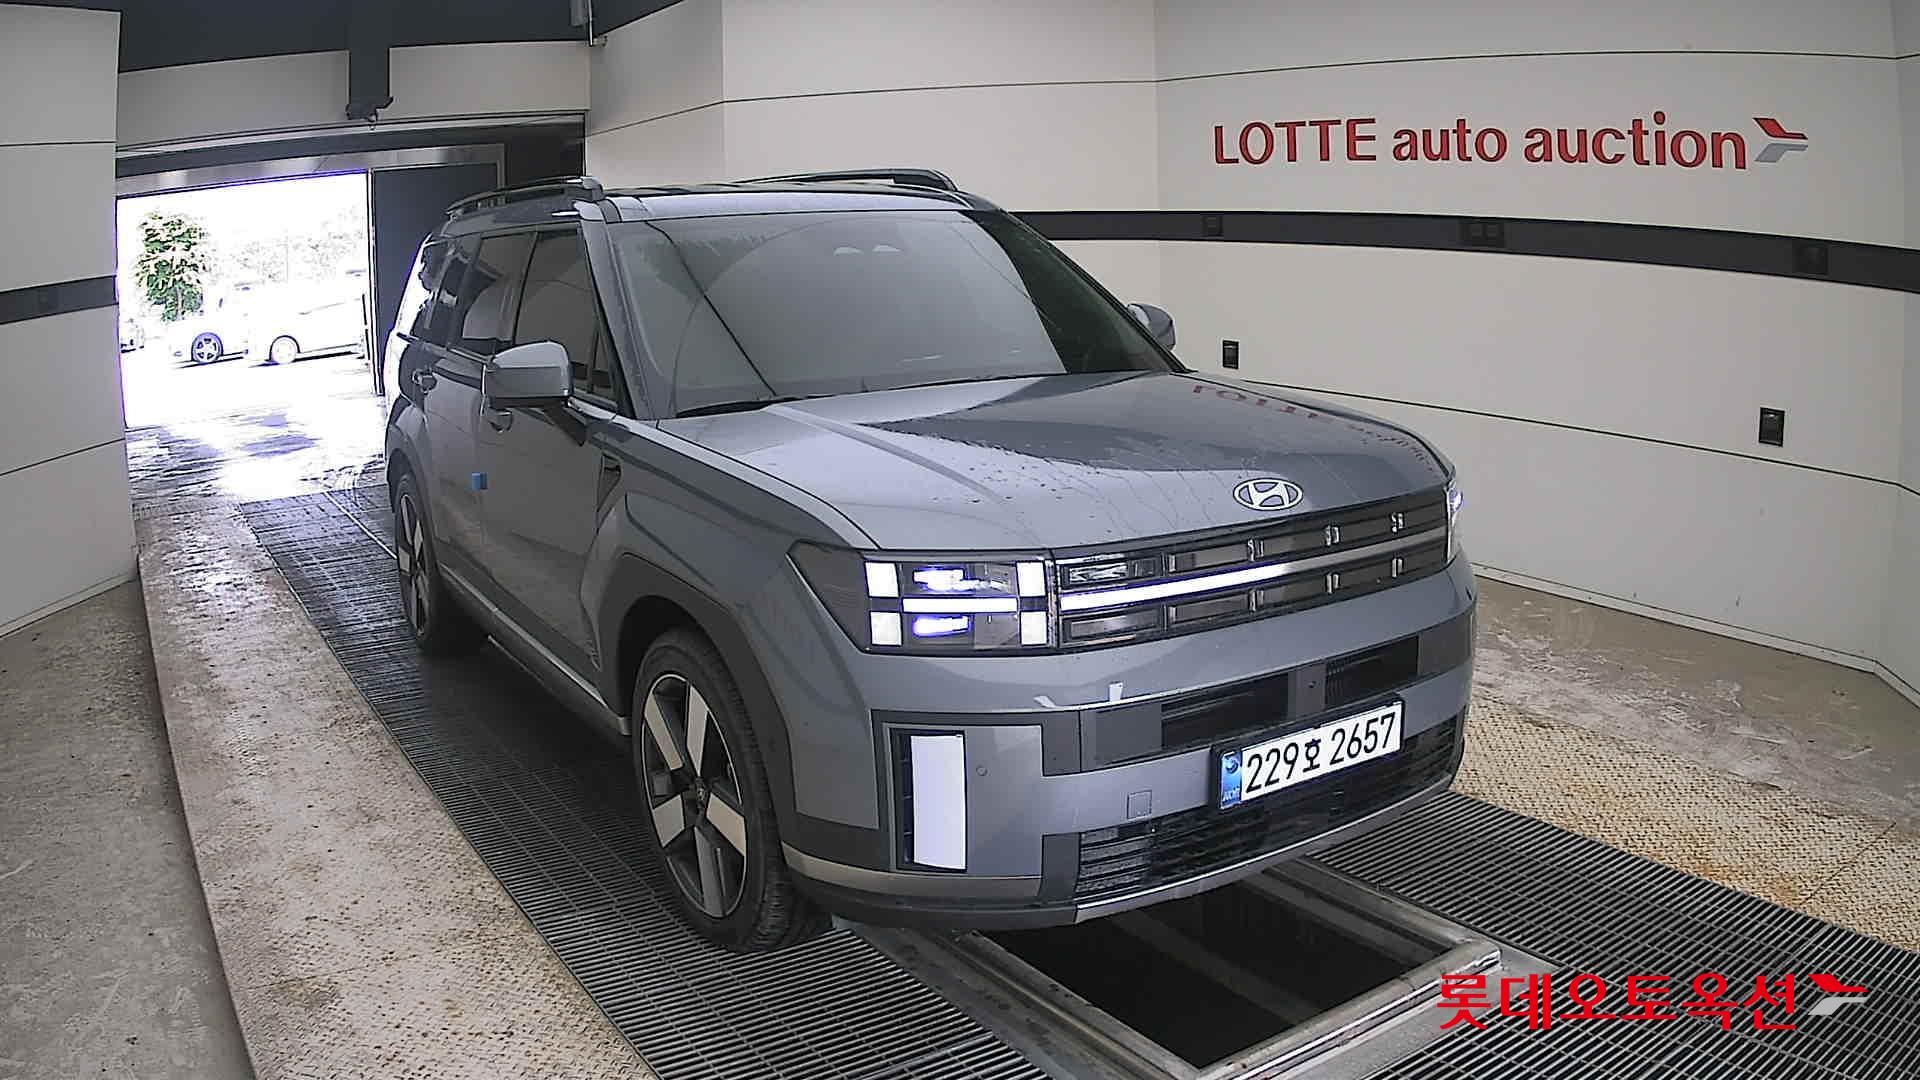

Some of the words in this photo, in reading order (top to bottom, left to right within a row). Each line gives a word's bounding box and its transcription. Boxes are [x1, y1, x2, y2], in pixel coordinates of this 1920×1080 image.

[1214, 119, 1376, 164] LOTTE
[1392, 118, 1508, 164] auto
[1524, 111, 1747, 169] auction
[1246, 738, 1322, 793] 229호
[1329, 712, 1396, 765] 2657
